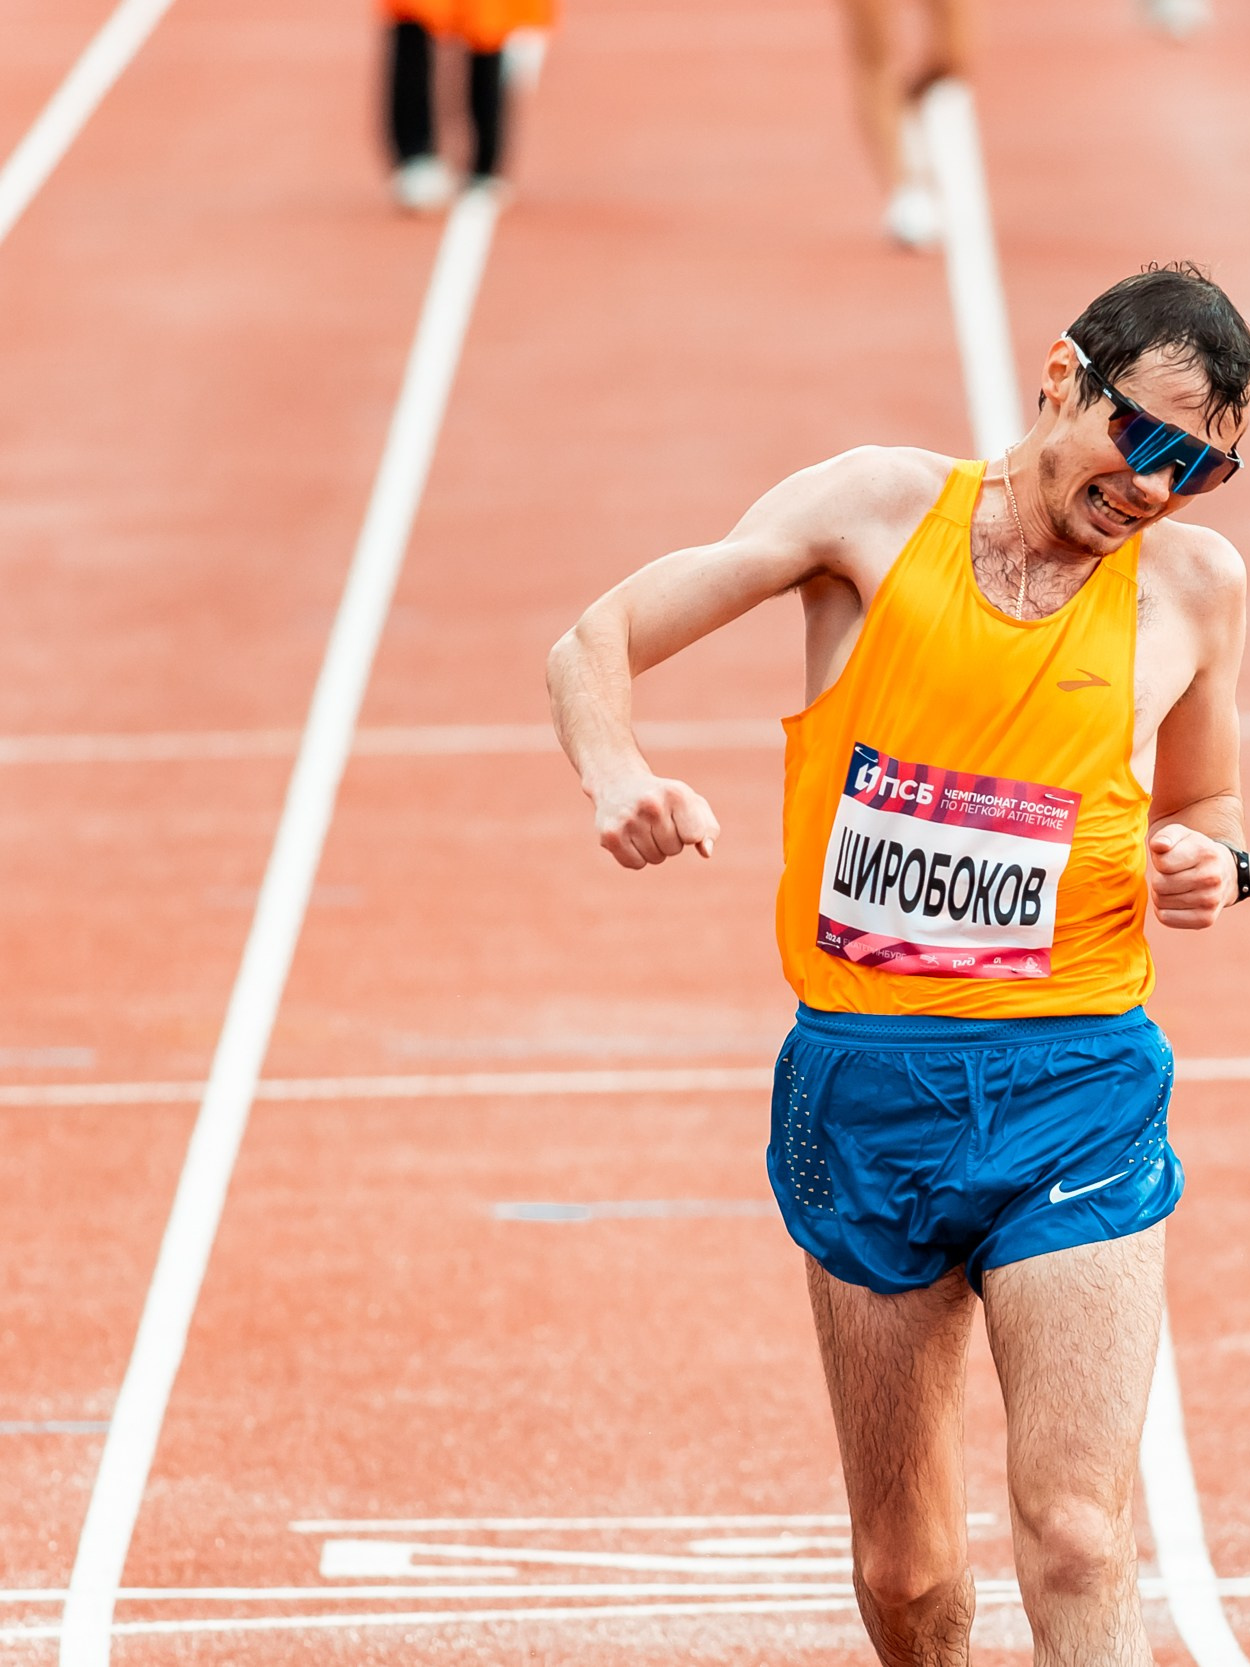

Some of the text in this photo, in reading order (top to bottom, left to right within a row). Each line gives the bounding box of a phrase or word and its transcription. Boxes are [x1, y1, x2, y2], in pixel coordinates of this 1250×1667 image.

[878, 775, 934, 805] ПСБ
[944, 788, 1069, 820] ЧЕМПИОНАТ РОССИИ
[940, 799, 1067, 830] ПО ЛЕГКОЙ АТЛЕТИКЕ
[833, 826, 1047, 926] ШИРОБОКОВ
[825, 931, 841, 944] 2024
